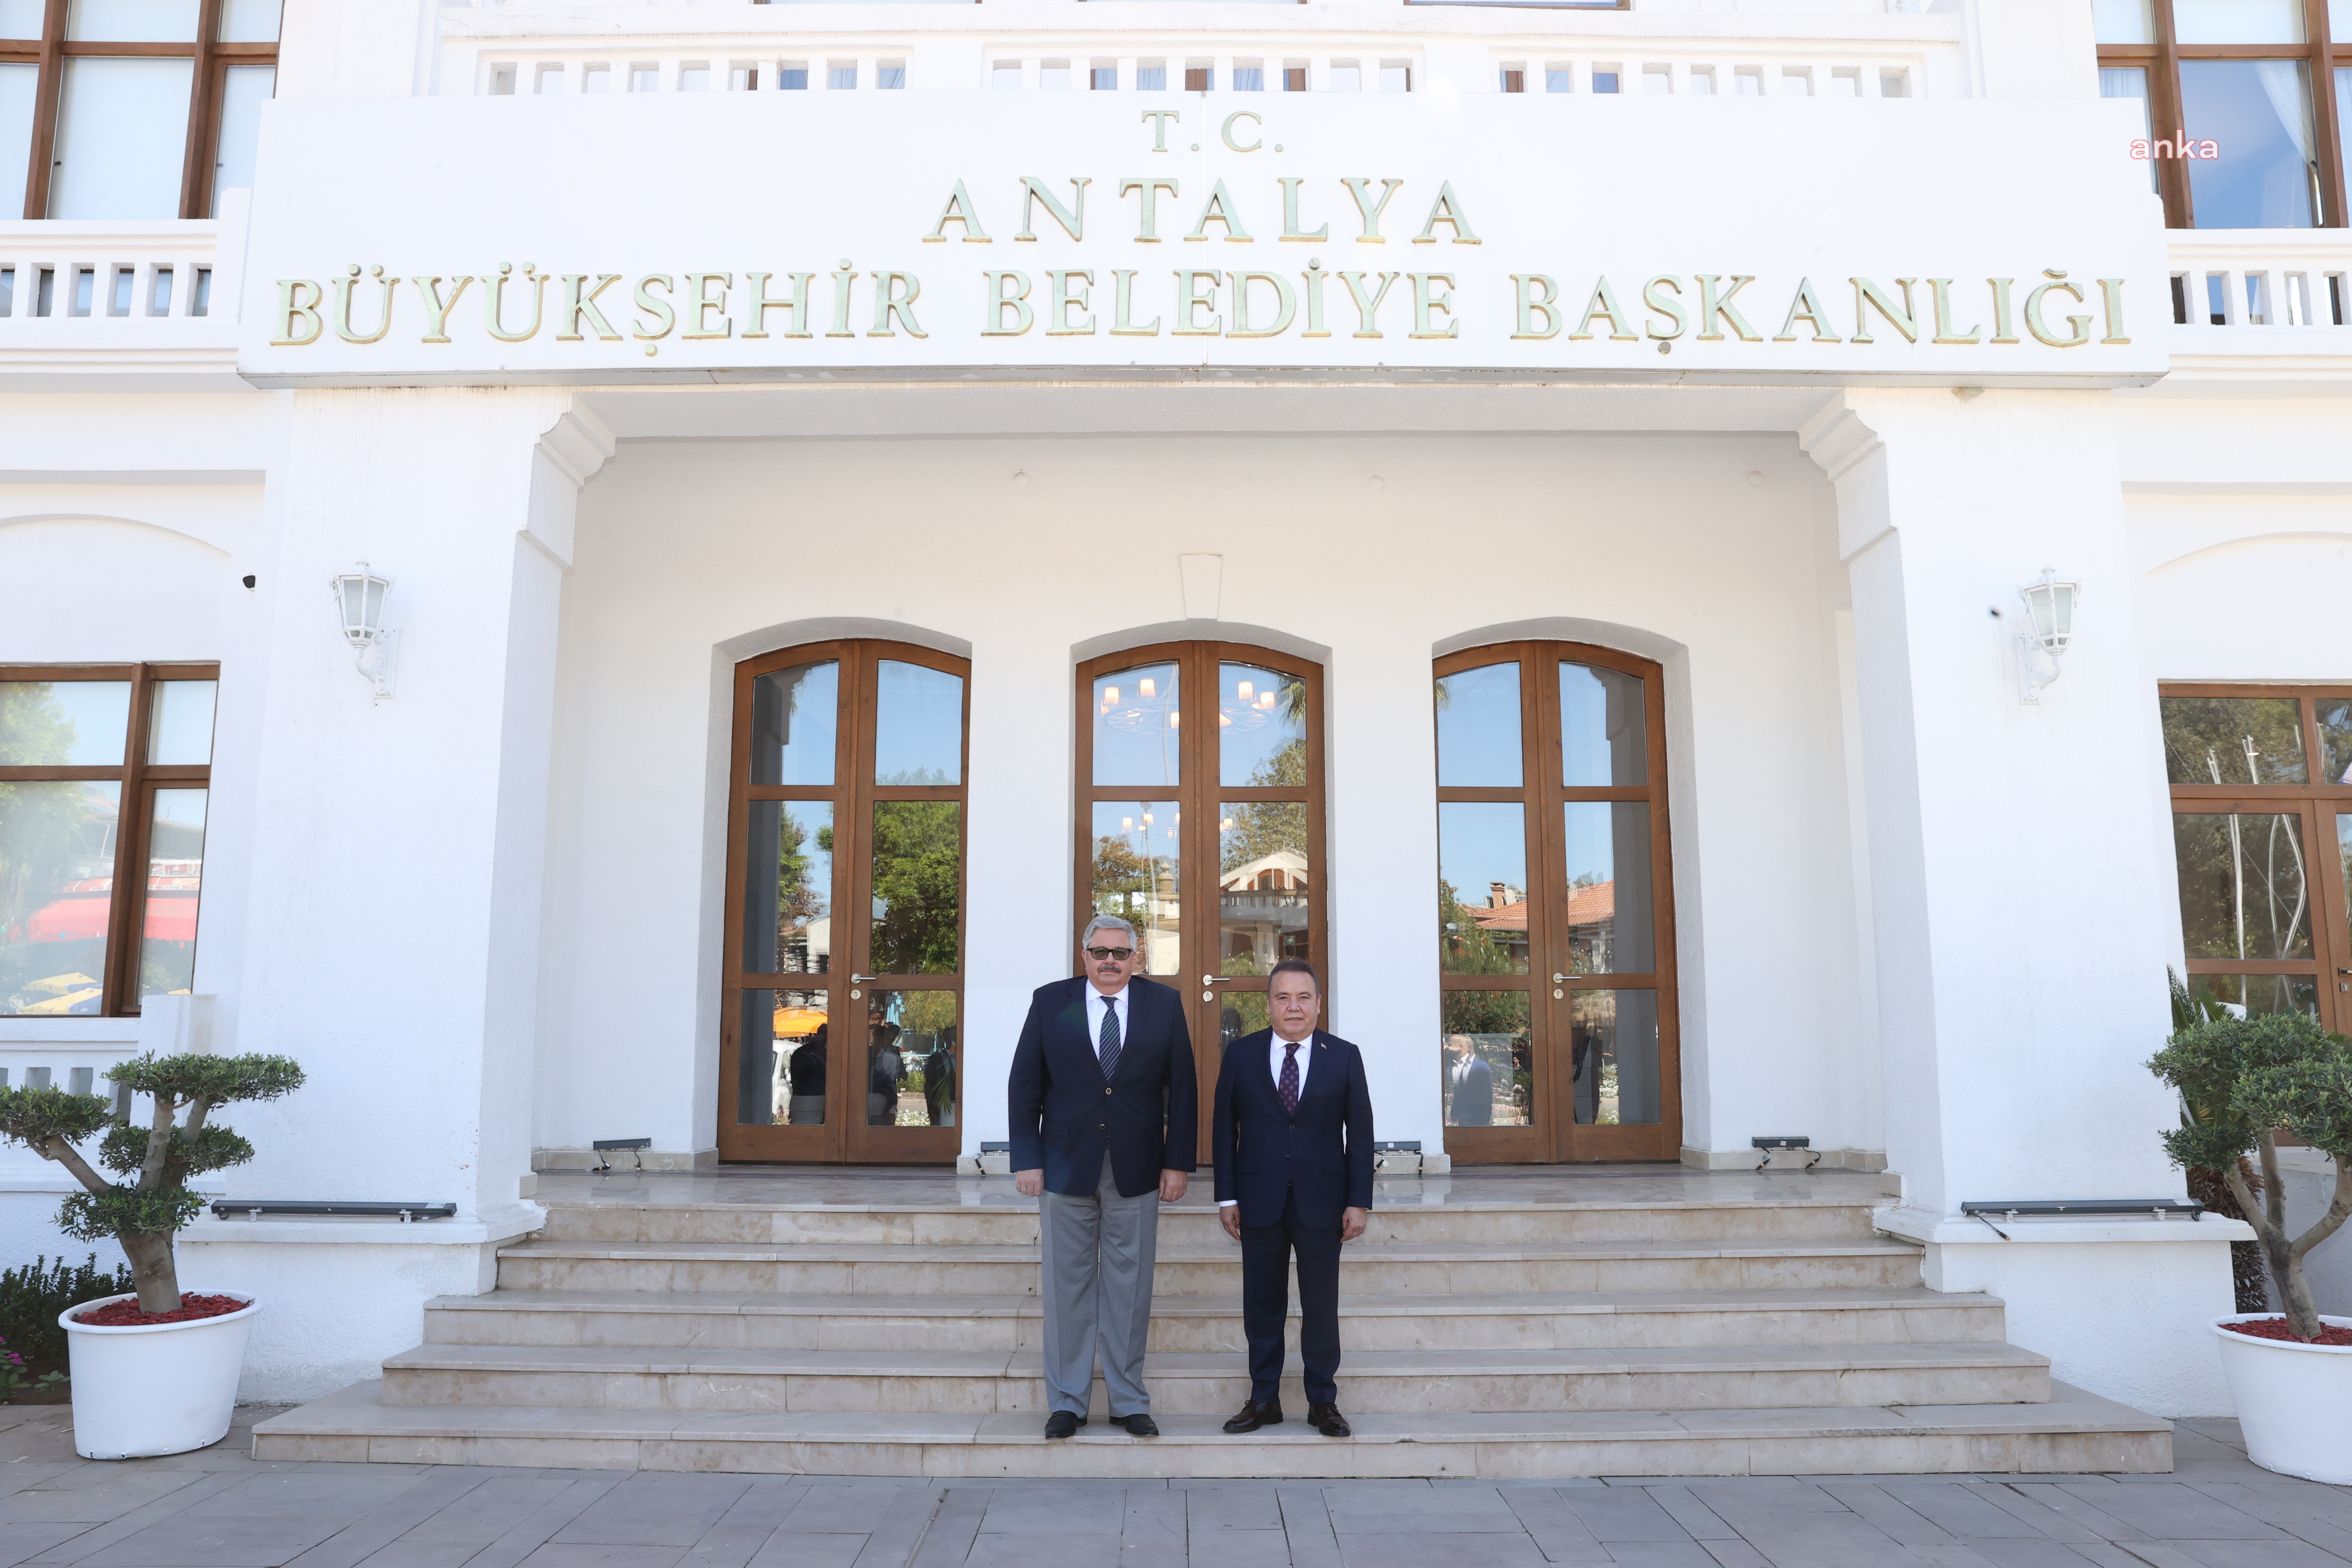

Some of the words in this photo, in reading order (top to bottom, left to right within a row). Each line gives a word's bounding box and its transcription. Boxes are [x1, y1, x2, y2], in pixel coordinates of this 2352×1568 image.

[922, 176, 1482, 245] ANTALYA
[270, 258, 929, 356] BÜYÜKŞEHİR
[980, 258, 1458, 339] BELEDİYE
[1510, 268, 2132, 354] BAŞKANLIĞI
